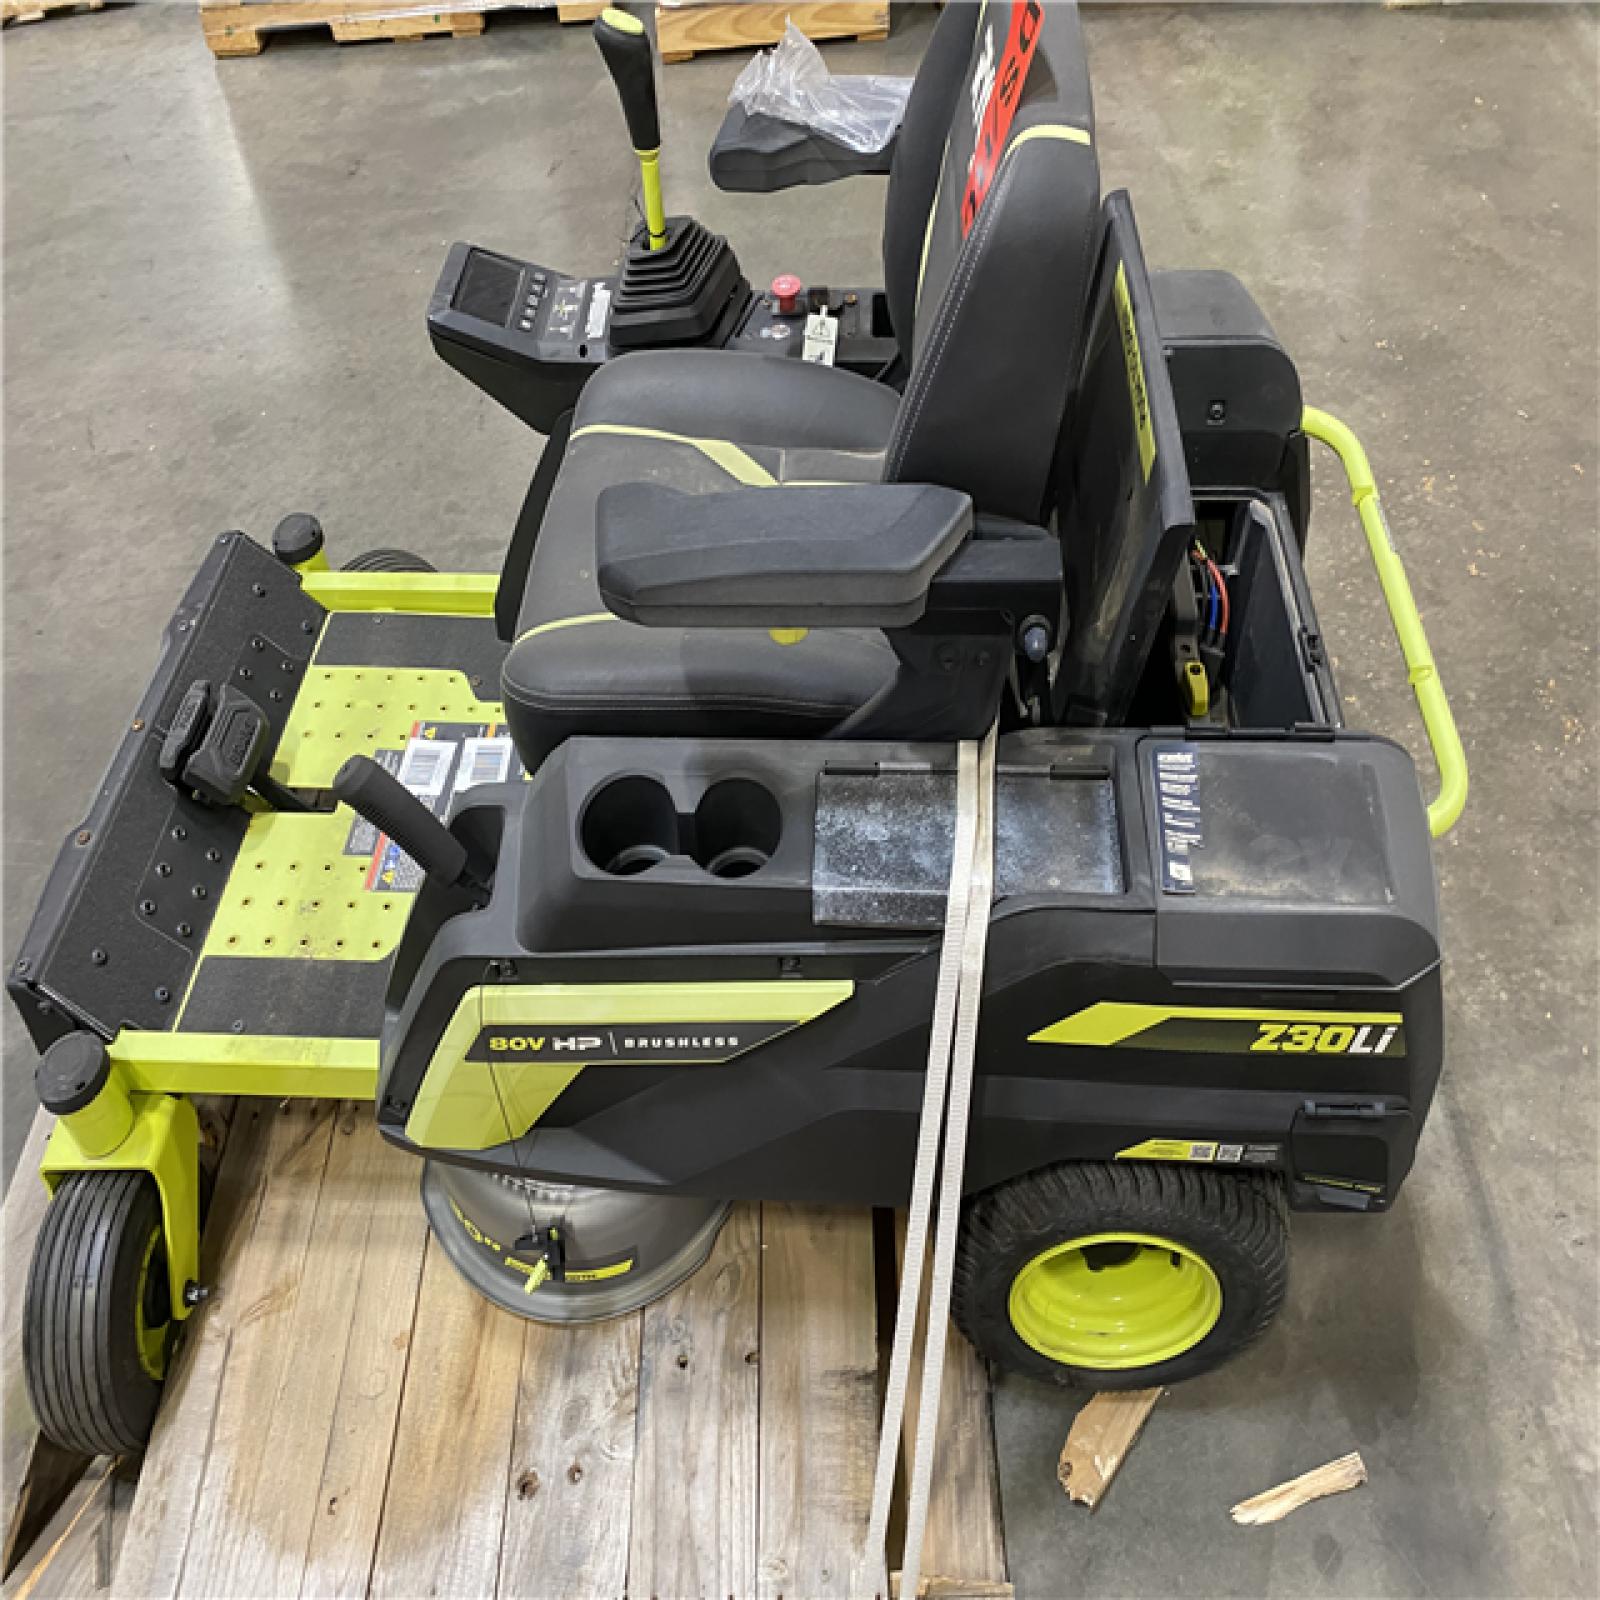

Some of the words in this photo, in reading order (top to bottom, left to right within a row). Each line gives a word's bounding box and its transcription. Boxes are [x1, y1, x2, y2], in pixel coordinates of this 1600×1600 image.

[489, 1036, 546, 1051] 80V
[552, 1036, 604, 1051] HP
[624, 1036, 739, 1049] BRUSHLESS
[1250, 1023, 1398, 1054] Z30Li
